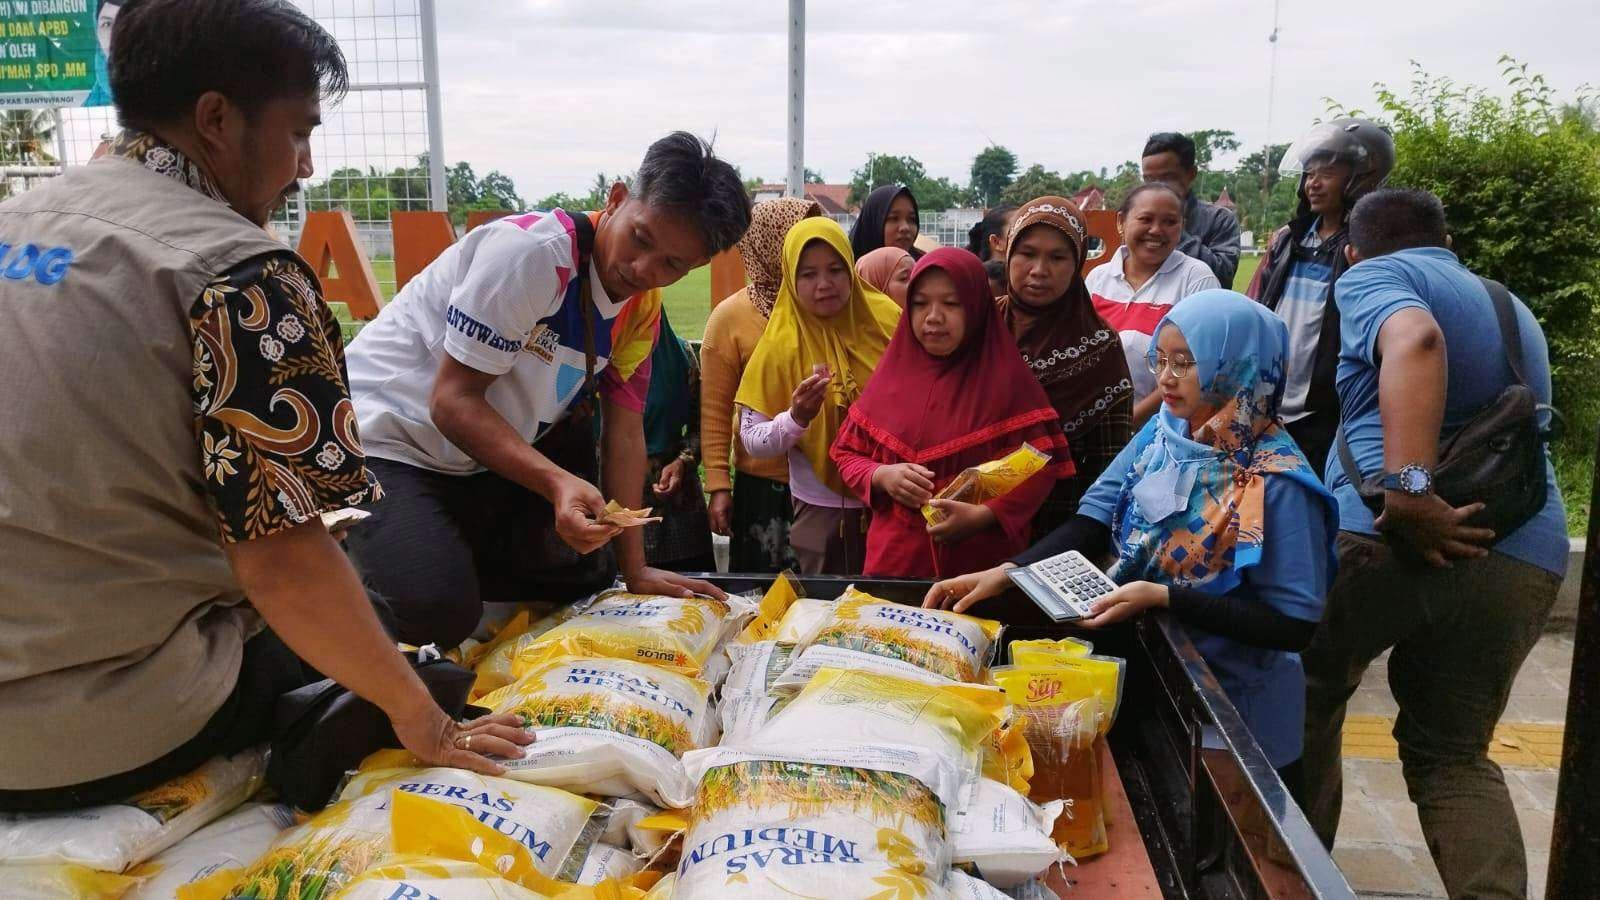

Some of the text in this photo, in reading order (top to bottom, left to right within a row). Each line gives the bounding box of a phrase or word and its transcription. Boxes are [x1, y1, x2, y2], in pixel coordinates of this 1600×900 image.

[31, 0, 87, 14] DIBANGUN
[9, 22, 36, 37] DANA
[39, 20, 69, 36] APBD
[10, 43, 36, 58] OLEH
[880, 606, 955, 626] BERAS
[875, 611, 978, 656] MEDIUM
[637, 648, 675, 662] BULOG
[399, 783, 515, 813] BERAS
[680, 827, 858, 880] MEDIUM
